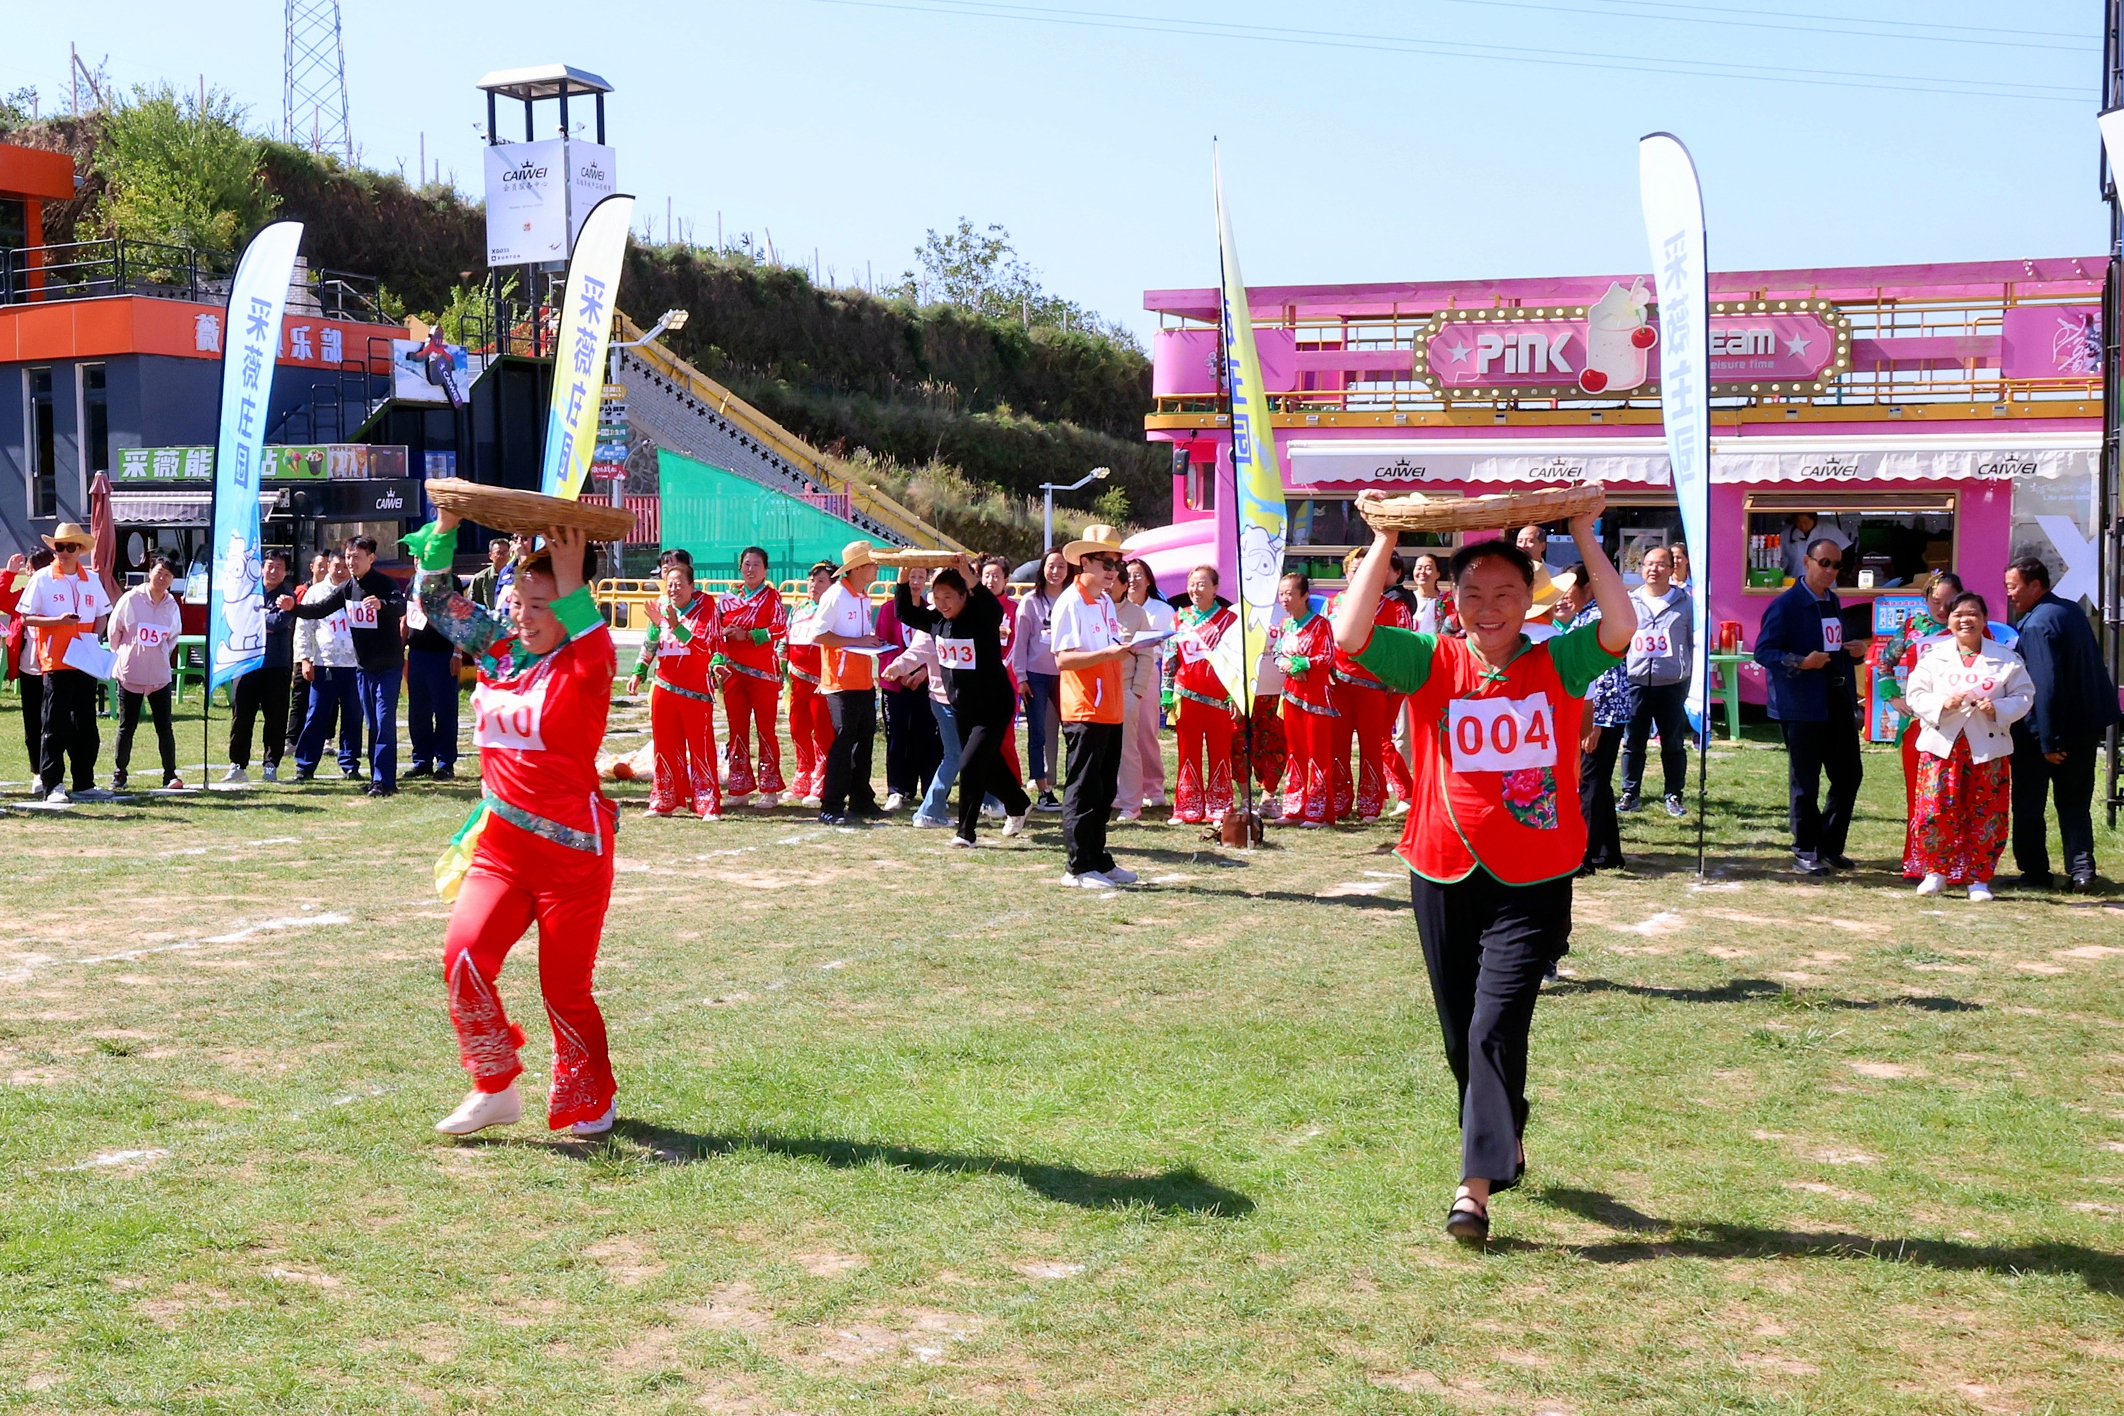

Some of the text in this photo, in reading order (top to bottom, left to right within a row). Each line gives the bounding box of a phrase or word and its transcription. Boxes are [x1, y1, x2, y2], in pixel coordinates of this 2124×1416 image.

[502, 167, 548, 182] CAIWEI
[581, 167, 605, 181] CAIWEI
[1710, 360, 1746, 370] eisure
[233, 296, 272, 489] 采薇庄园
[442, 371, 460, 402] CAIWEI
[1374, 467, 1426, 478] CAIWEI
[1528, 466, 1582, 478] CAIWEI
[1800, 465, 1858, 477] CAIWEI
[1977, 463, 2038, 475] CAIWEI
[375, 497, 403, 510] CAIWEI
[53, 594, 65, 602] 58
[1635, 635, 1668, 652] 033
[937, 643, 973, 663] 013
[1948, 673, 1996, 691] 005
[1456, 709, 1550, 756] 004
